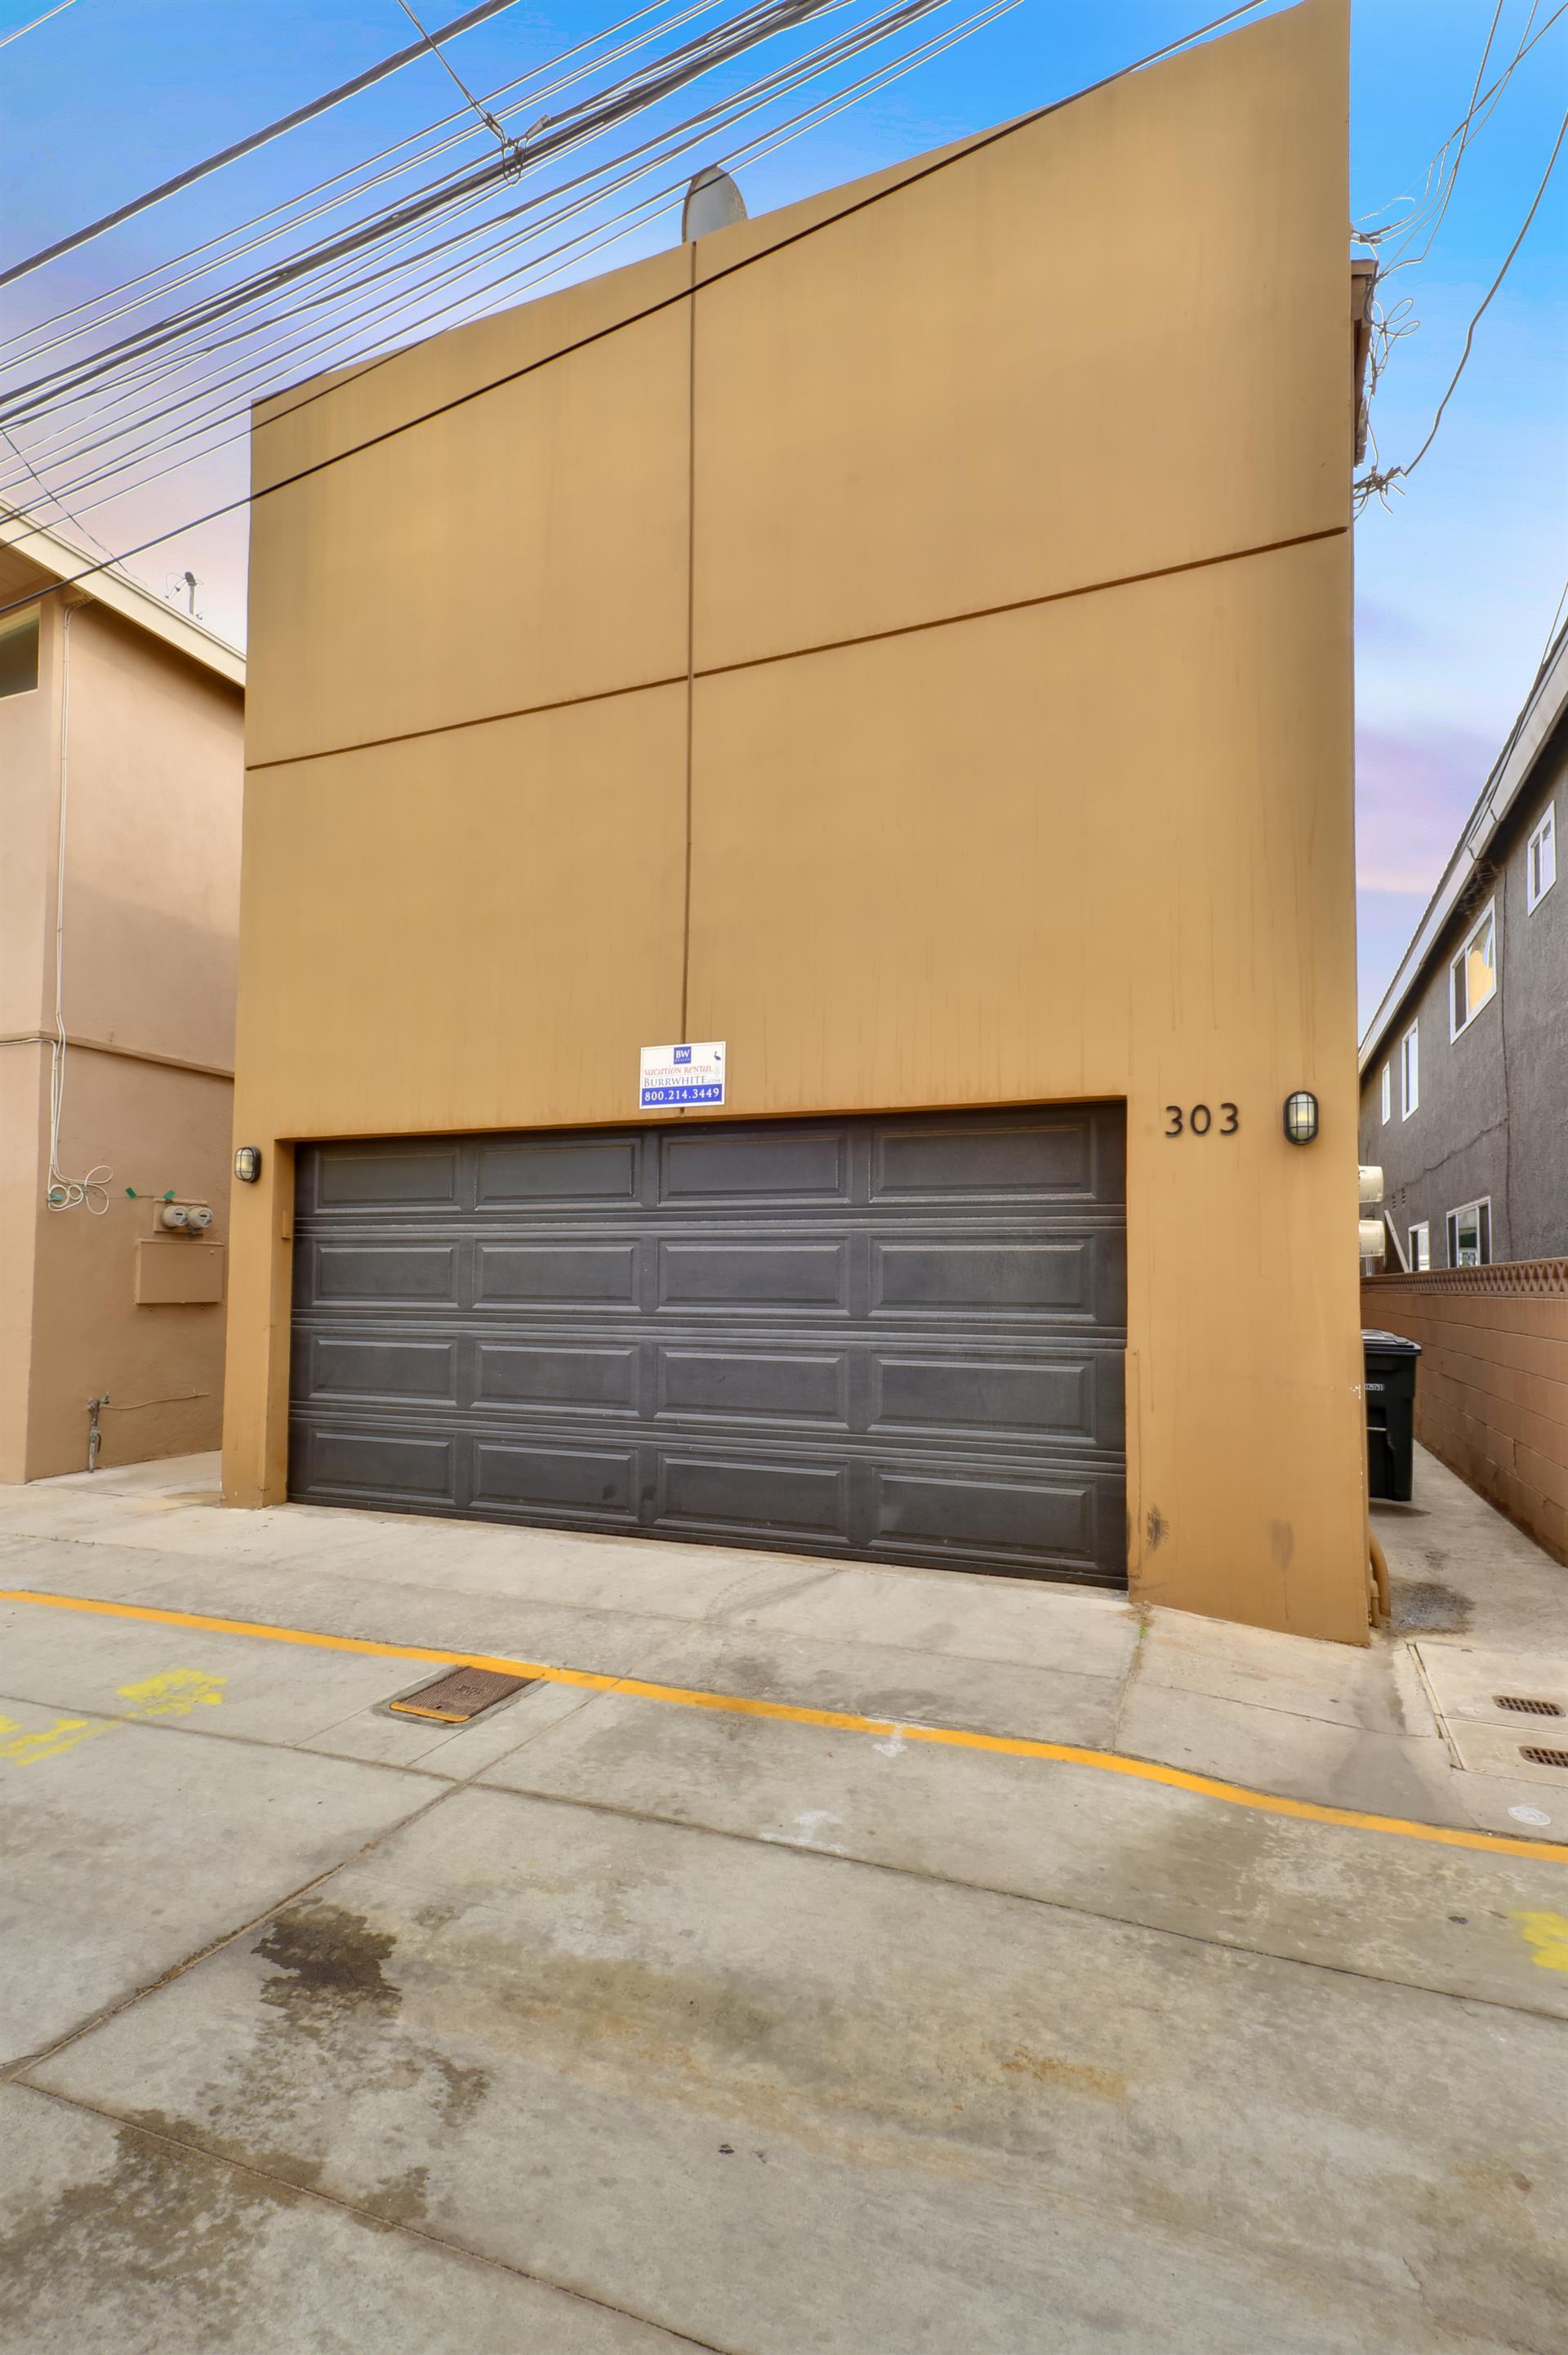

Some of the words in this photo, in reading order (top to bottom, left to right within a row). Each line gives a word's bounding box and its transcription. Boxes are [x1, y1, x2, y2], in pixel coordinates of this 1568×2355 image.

[675, 1050, 690, 1058] BW
[644, 1087, 719, 1101] 800.214.3449
[1165, 1102, 1239, 1137] 303
